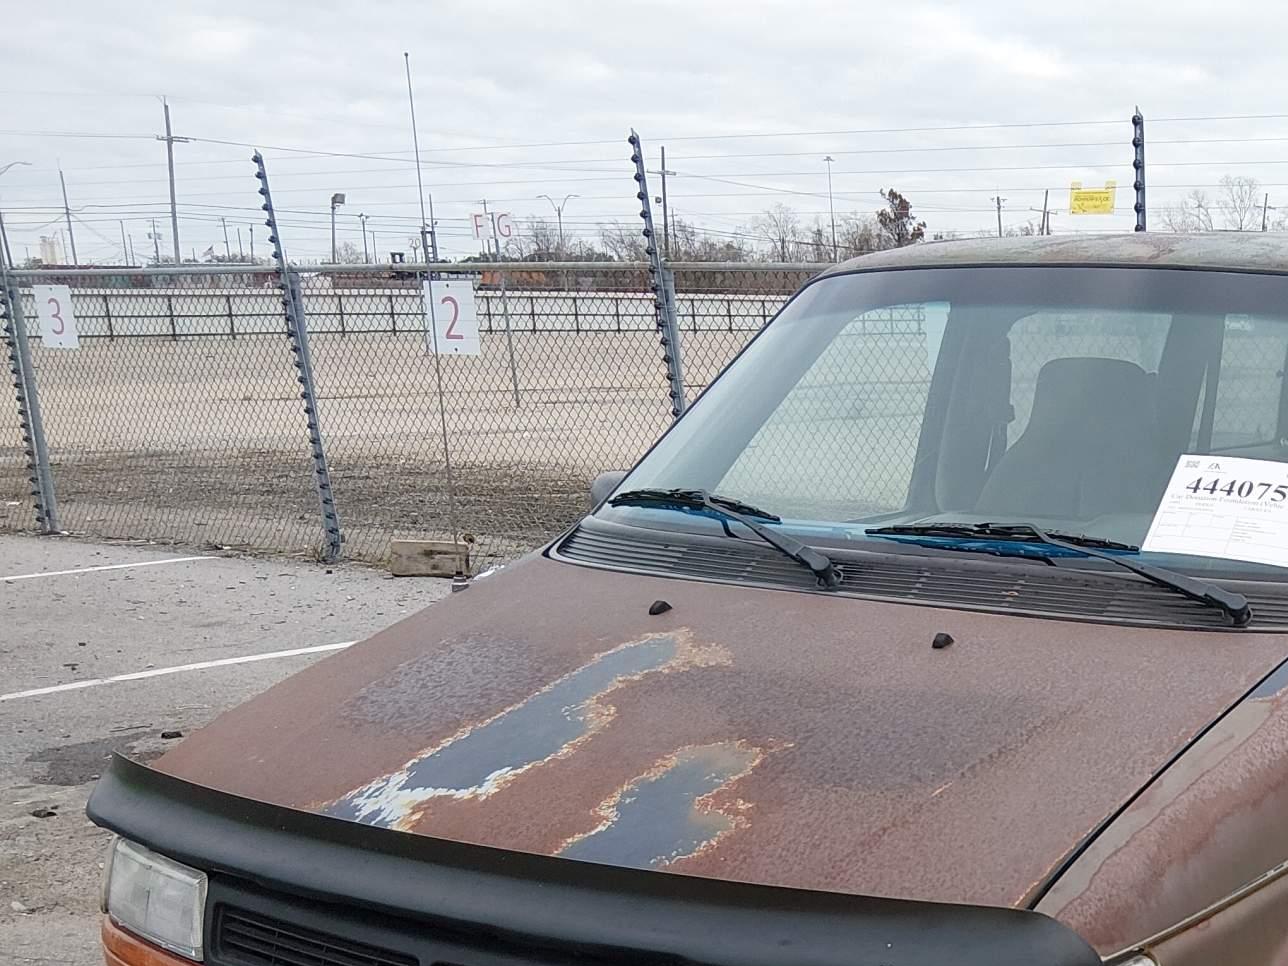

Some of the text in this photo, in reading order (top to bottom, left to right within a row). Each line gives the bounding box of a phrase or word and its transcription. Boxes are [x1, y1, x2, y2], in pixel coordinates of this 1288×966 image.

[474, 214, 483, 238] F
[497, 213, 511, 238] G
[47, 297, 65, 335] 3
[441, 295, 464, 339] 2
